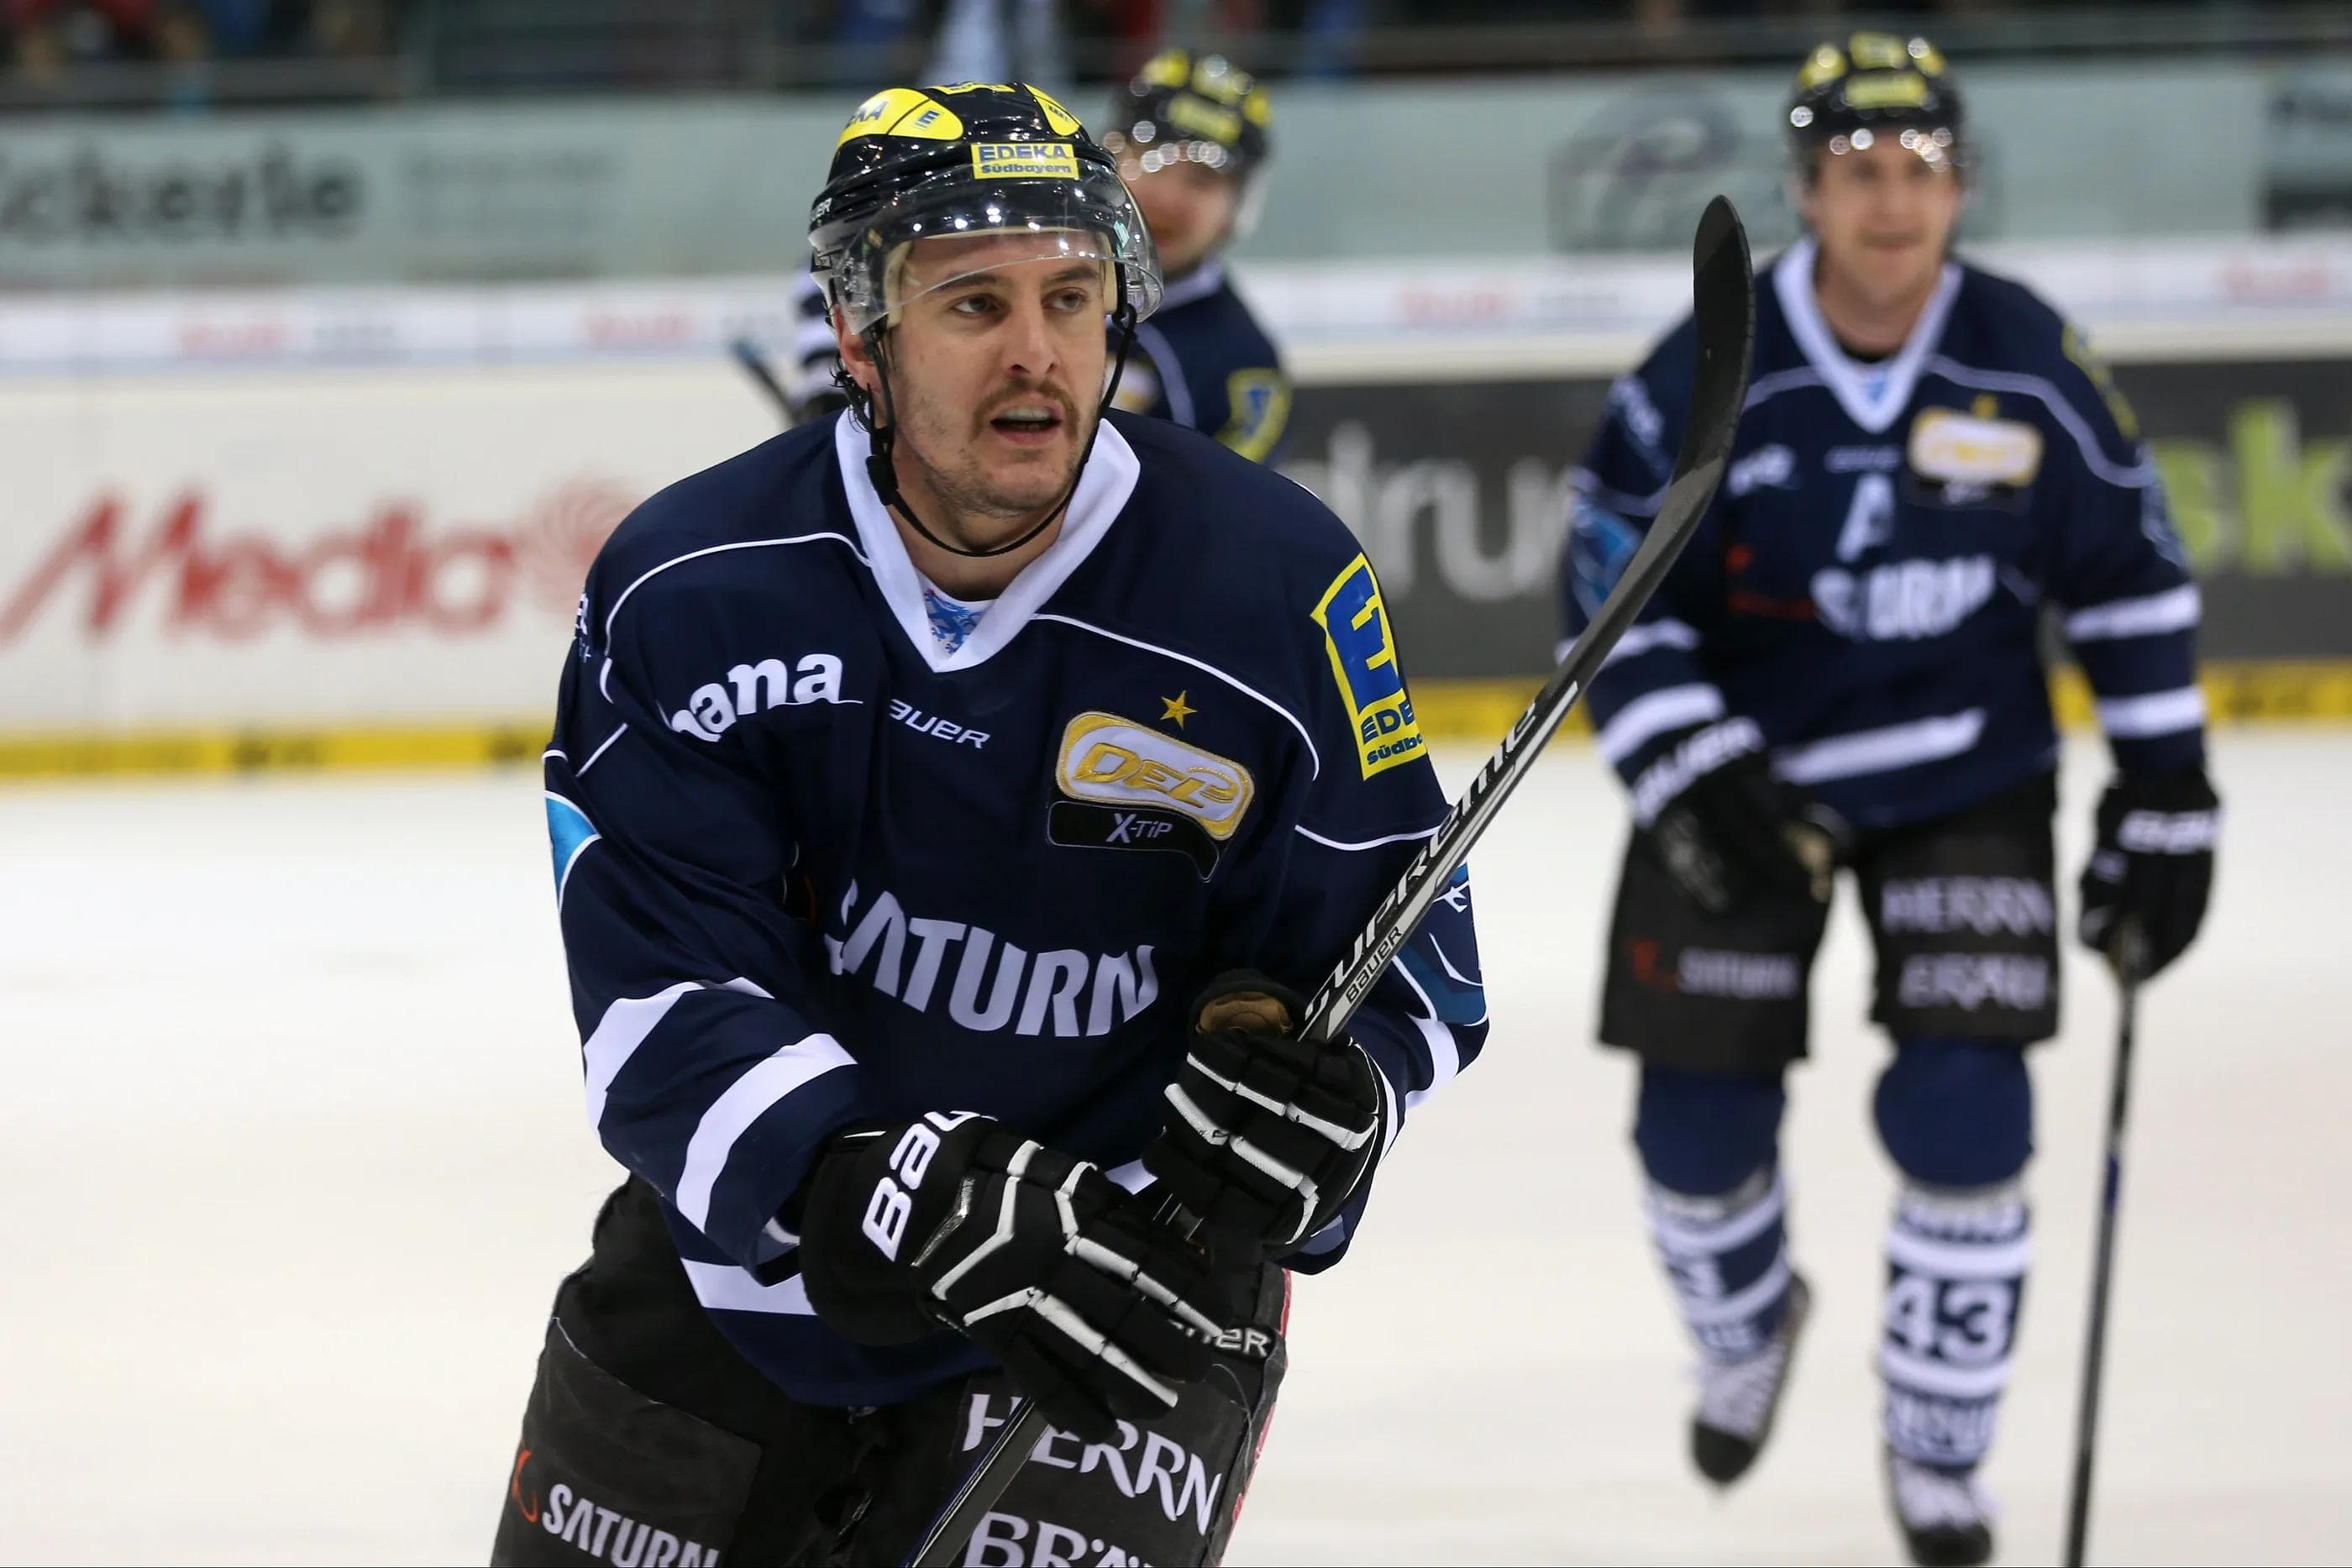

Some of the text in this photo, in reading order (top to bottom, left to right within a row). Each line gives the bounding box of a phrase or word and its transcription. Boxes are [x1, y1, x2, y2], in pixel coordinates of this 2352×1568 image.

[979, 145, 1067, 161] EDEKA
[981, 163, 1072, 174] Südbayern
[0, 485, 514, 645] Media
[1325, 564, 1402, 715] E
[1361, 699, 1415, 745] EDE
[1885, 1273, 2016, 1362] 43
